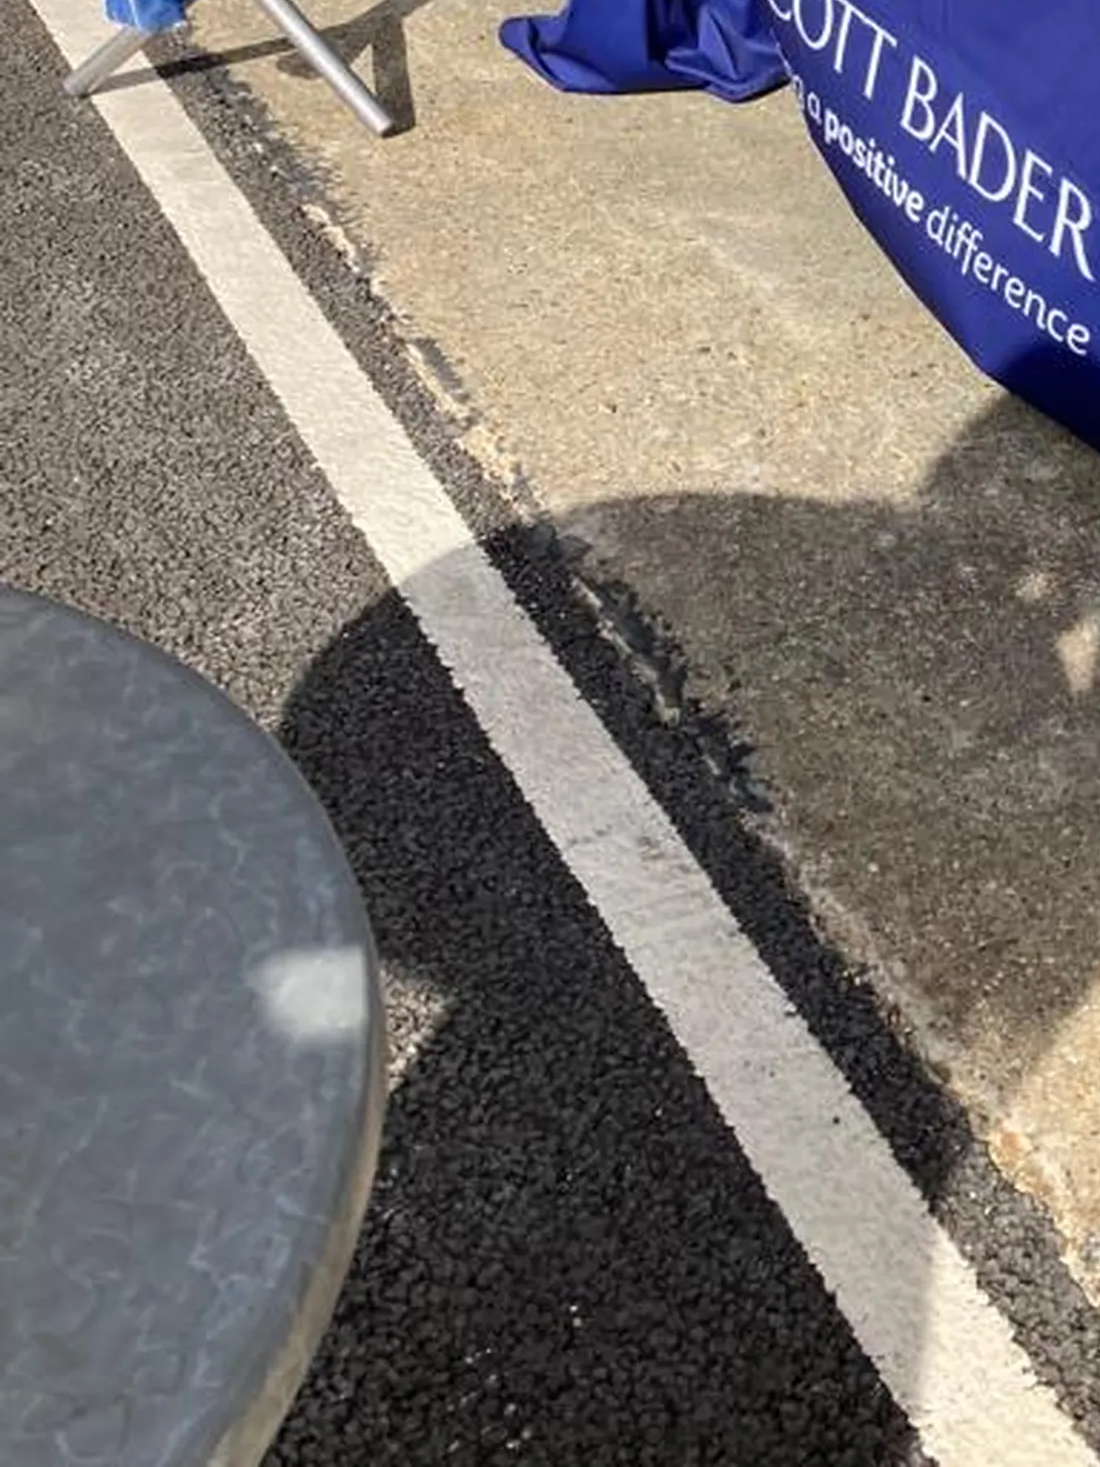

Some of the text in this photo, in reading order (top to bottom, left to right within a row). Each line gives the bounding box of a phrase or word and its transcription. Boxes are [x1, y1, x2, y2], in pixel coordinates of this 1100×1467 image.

[807, 92, 1093, 356] a positive difference
[901, 56, 1097, 282] BADER
